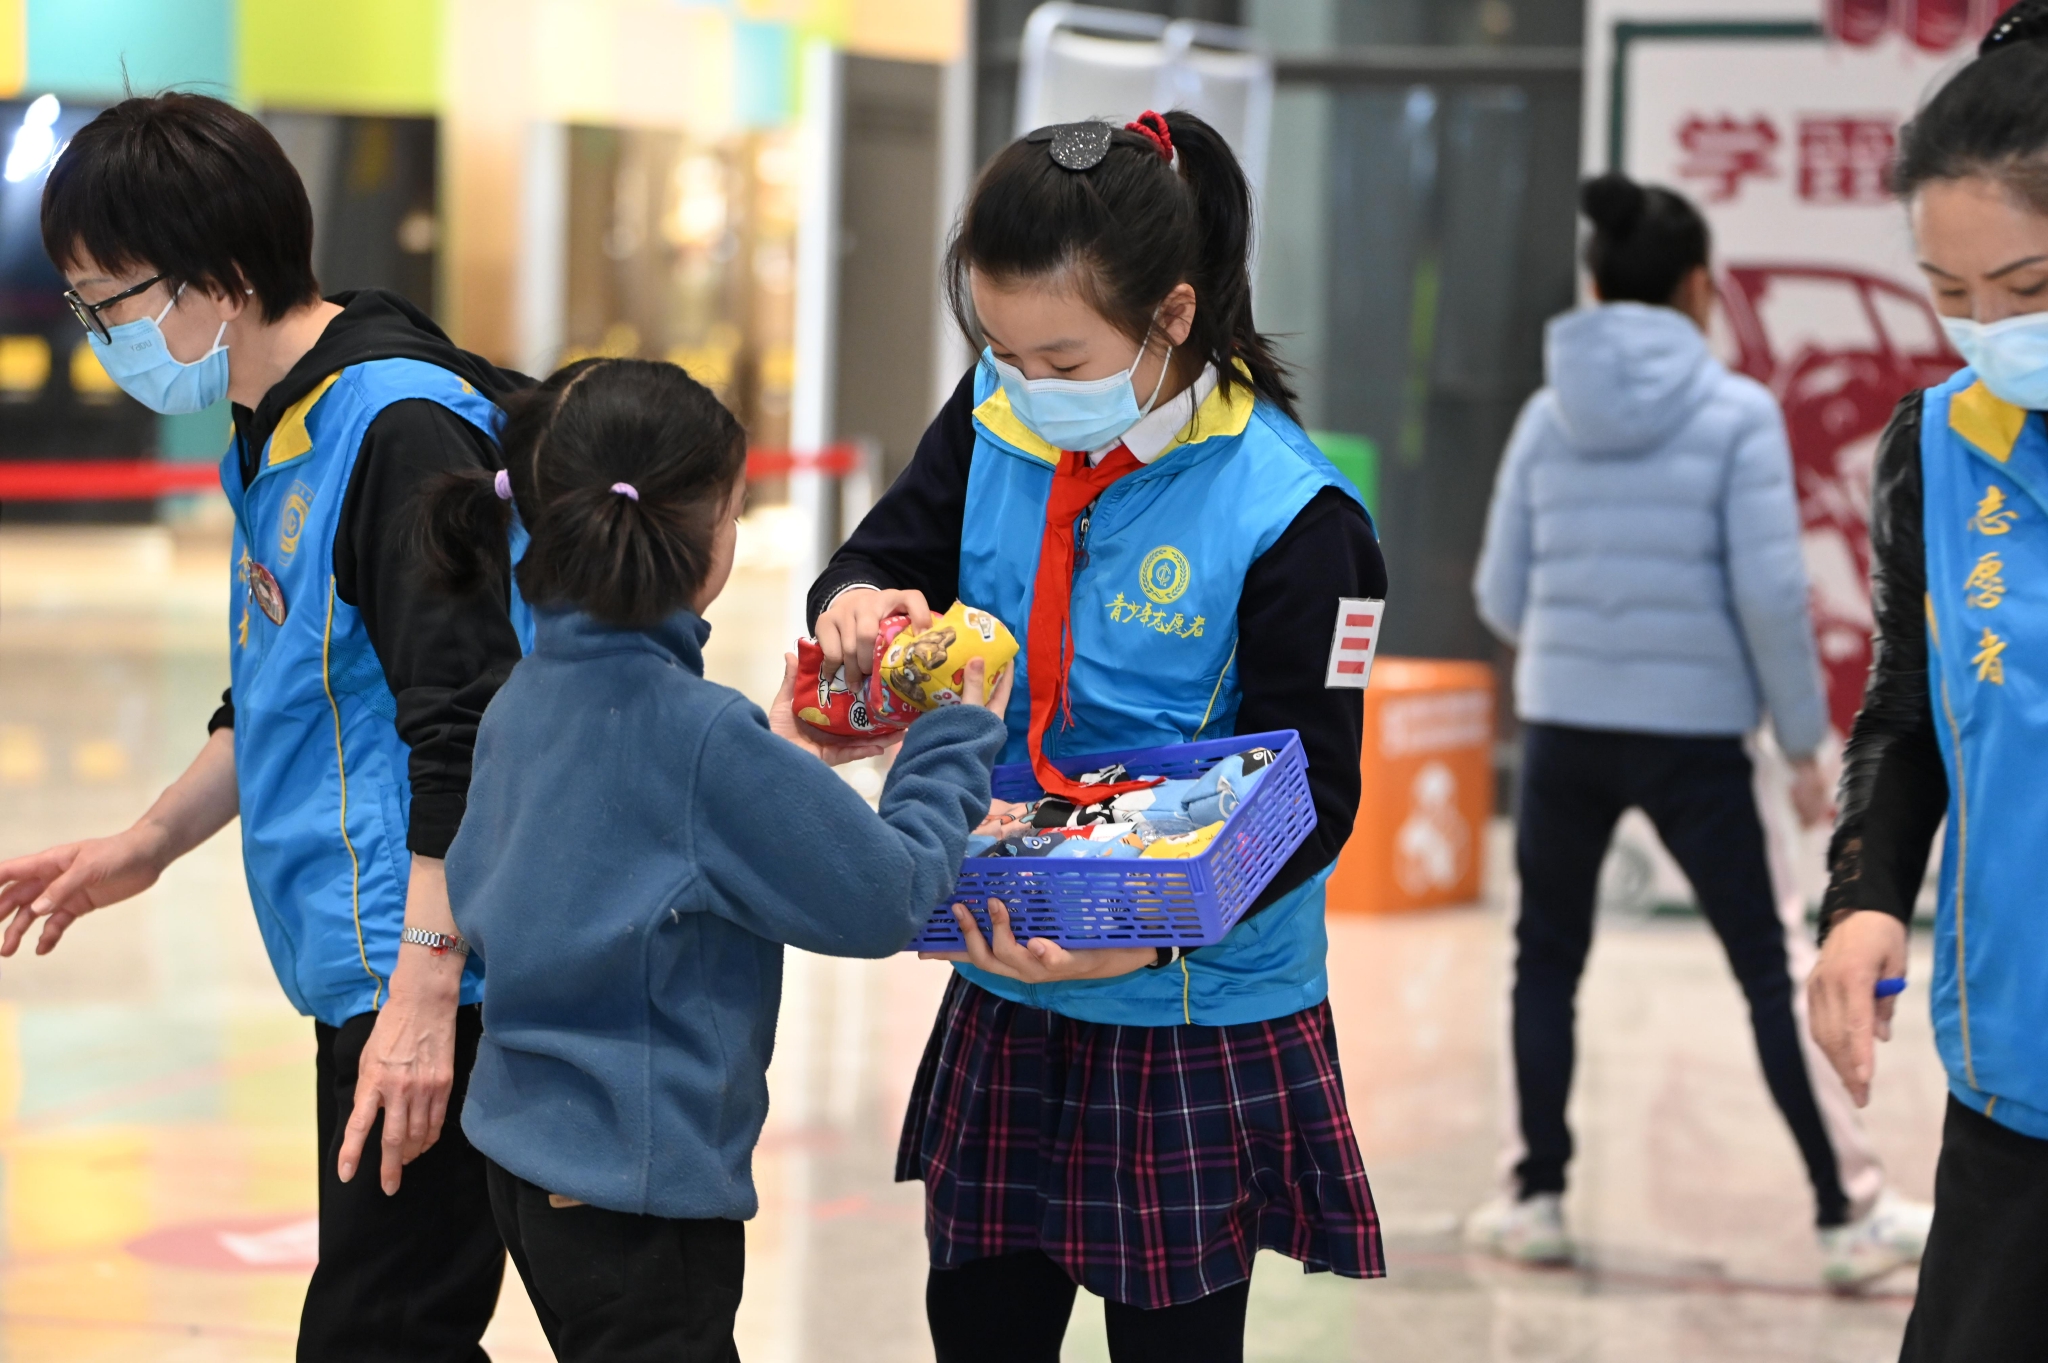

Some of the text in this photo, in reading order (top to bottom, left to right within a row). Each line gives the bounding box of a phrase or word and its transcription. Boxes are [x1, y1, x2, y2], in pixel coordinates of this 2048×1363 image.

[1105, 591, 1207, 639] 青少年志愿者
[1964, 484, 2020, 686] 志愿者
